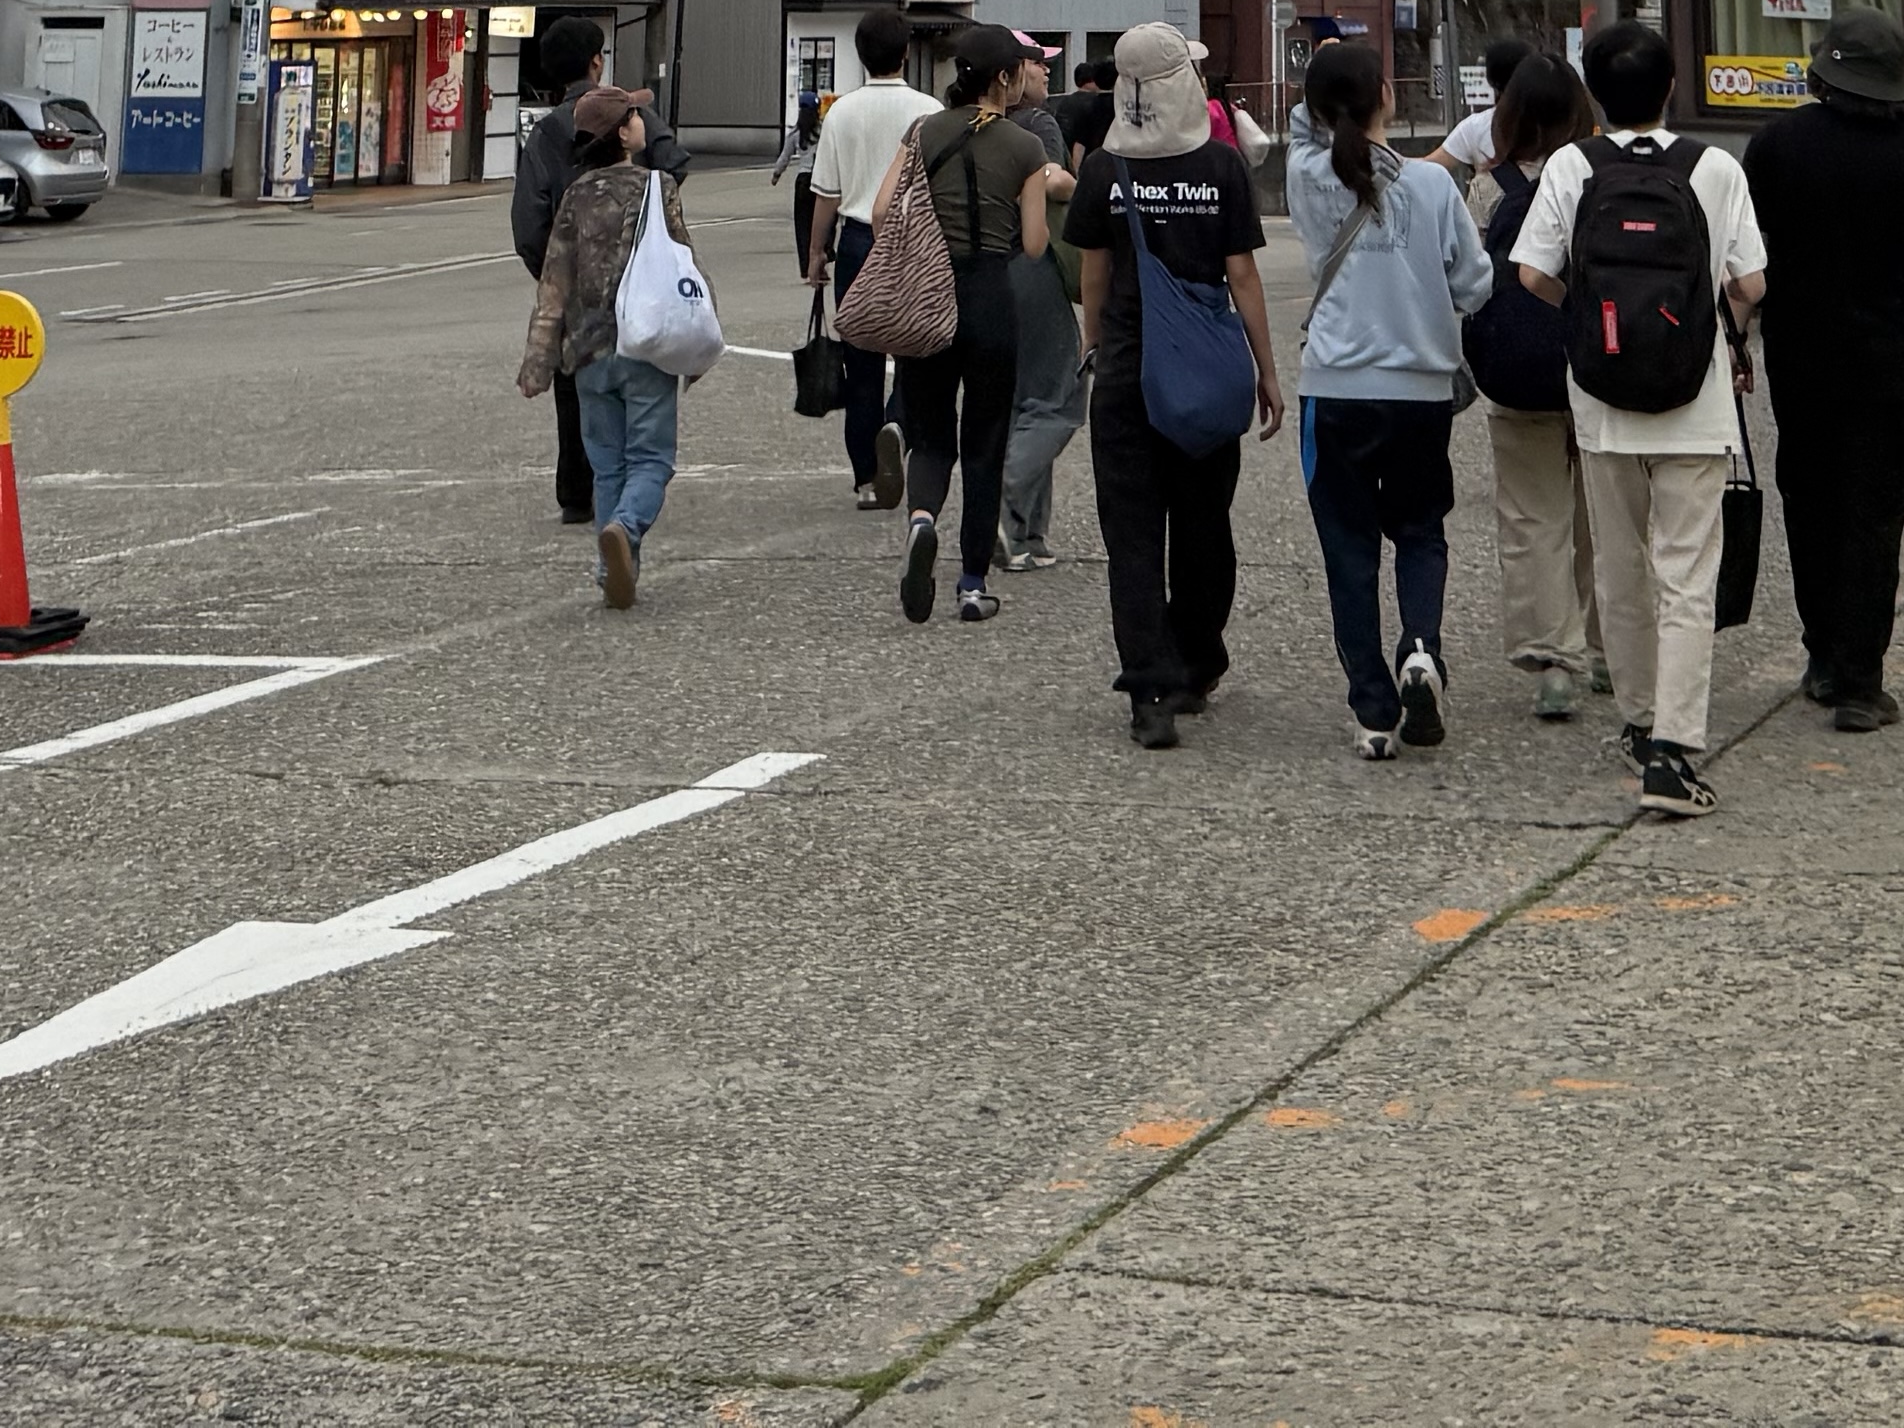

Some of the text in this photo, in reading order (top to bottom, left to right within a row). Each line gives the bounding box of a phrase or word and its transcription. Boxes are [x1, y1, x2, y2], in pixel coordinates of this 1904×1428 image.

[147, 18, 195, 34] コーヒー
[142, 45, 195, 64] レストラン
[131, 108, 202, 129] アートコーヒー
[1109, 180, 1219, 201] Ahex Twin
